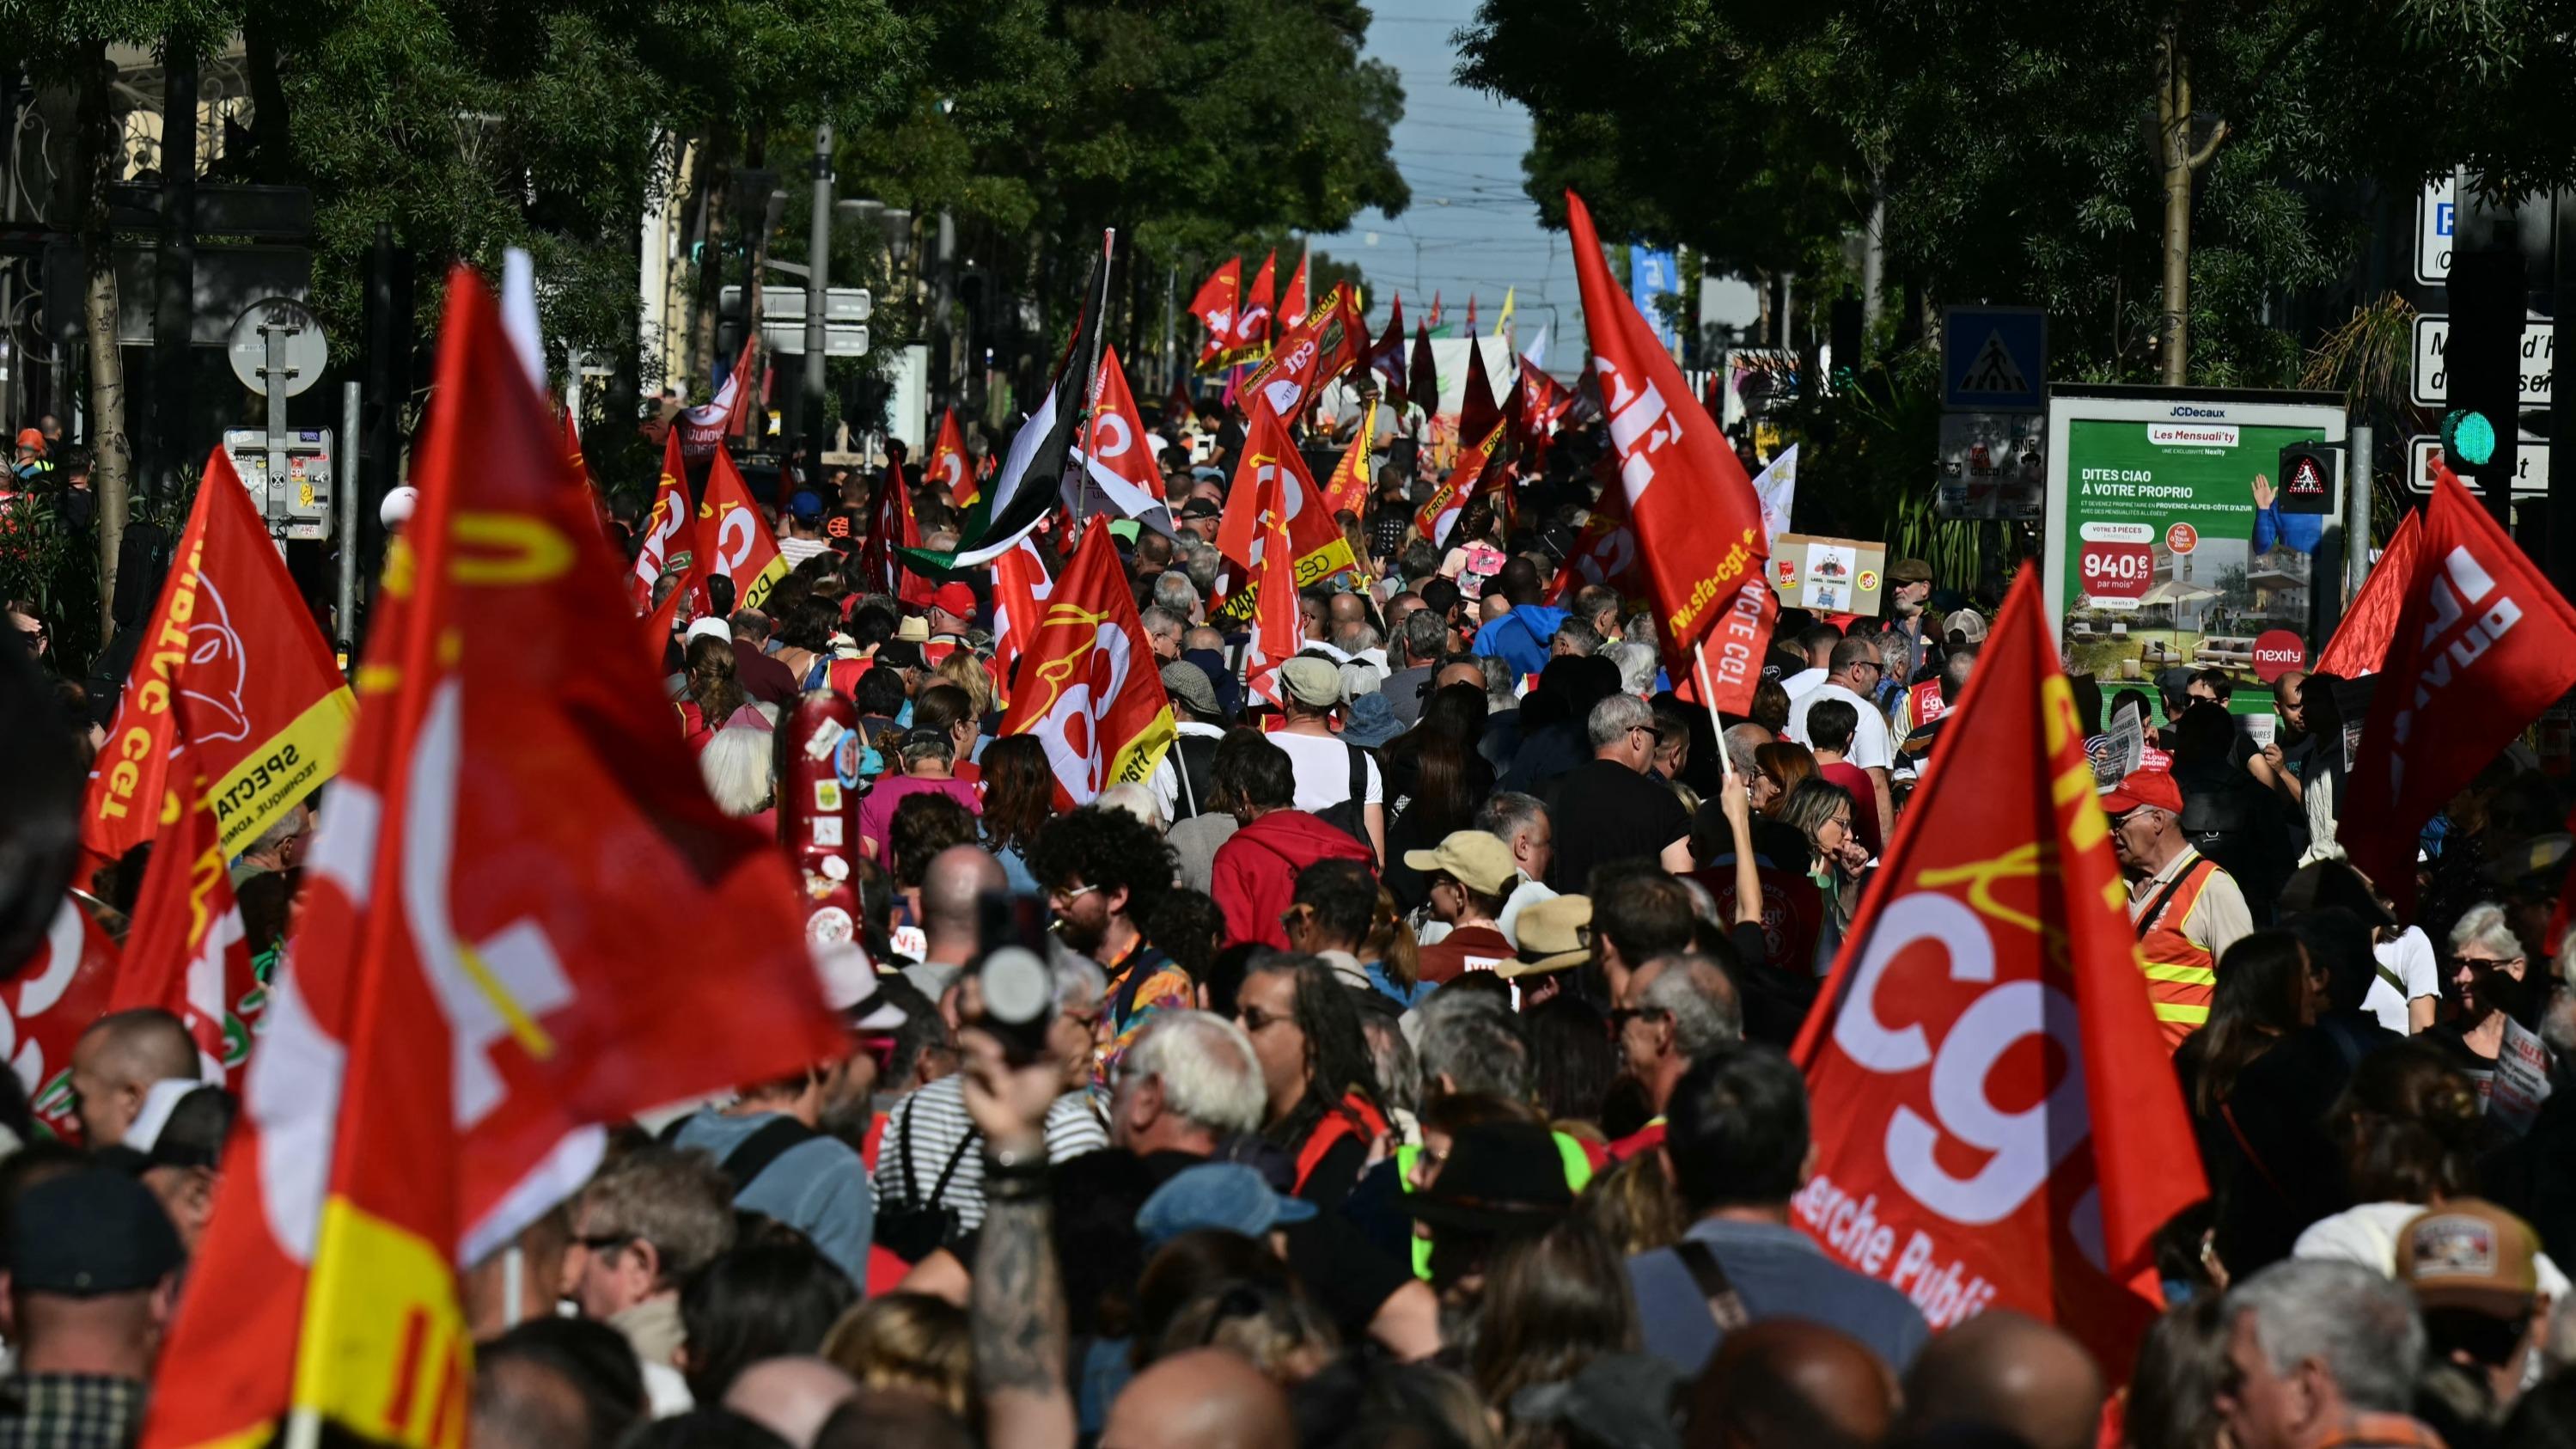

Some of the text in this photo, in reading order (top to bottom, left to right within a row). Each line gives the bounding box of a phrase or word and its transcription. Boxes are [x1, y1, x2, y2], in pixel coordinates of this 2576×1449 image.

[2170, 407, 2225, 418] JCDecaux
[2154, 430, 2173, 439] Les
[2205, 448, 2225, 456] Nexity
[2082, 468, 2152, 482] DITES CIAO
[2081, 480, 2193, 498] À VOTRE PROPRIO
[2156, 502, 2229, 511] PROVENCE-ALPES-CÔTE
[2085, 553, 2136, 578] 940
[1780, 572, 1795, 584] cgt
[2097, 580, 2109, 590] par
[2256, 648, 2301, 663] nexity
[1834, 894, 2101, 1229] cg
[1790, 1176, 1998, 1330] erche Publi
